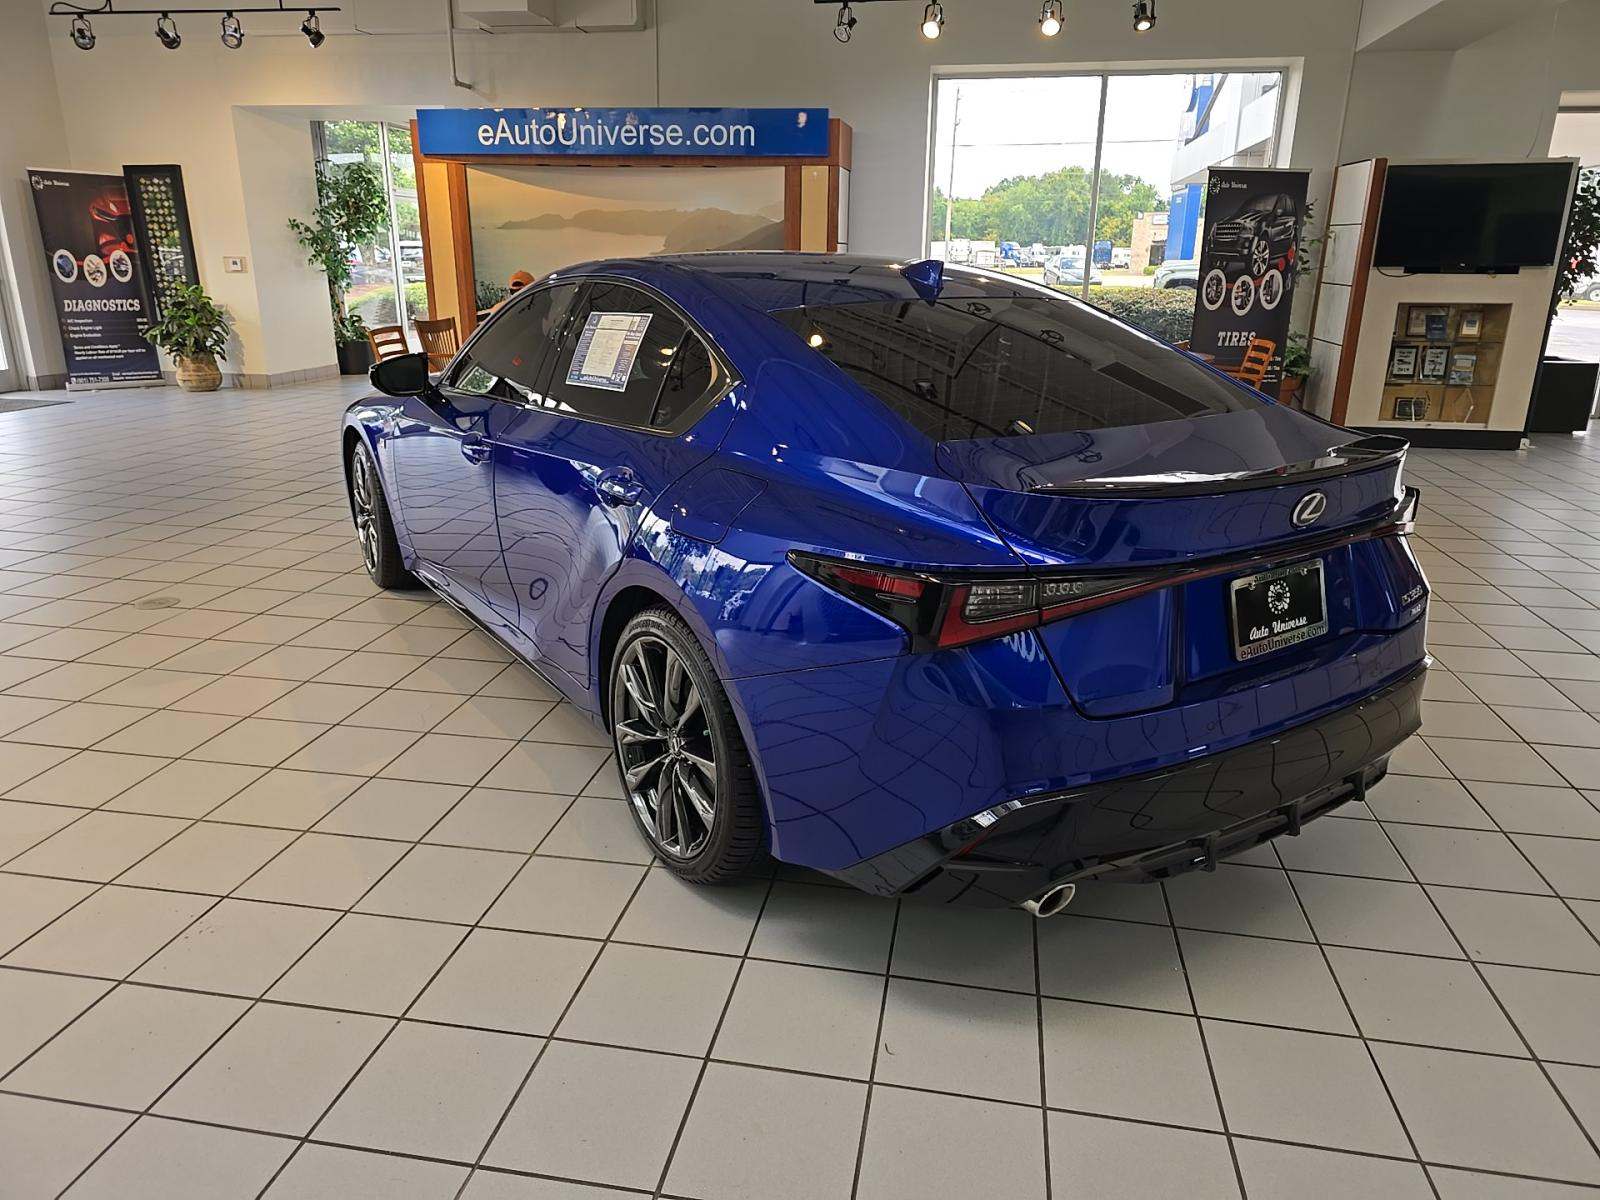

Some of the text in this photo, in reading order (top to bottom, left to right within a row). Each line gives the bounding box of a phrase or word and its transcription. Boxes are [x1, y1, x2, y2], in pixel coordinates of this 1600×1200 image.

[478, 118, 755, 146] eAutoUniverse.com
[63, 299, 141, 312] DIAGNOSTICS
[1249, 616, 1308, 640] Auto Universe
[1240, 625, 1328, 659] eAutoUniverse.com
